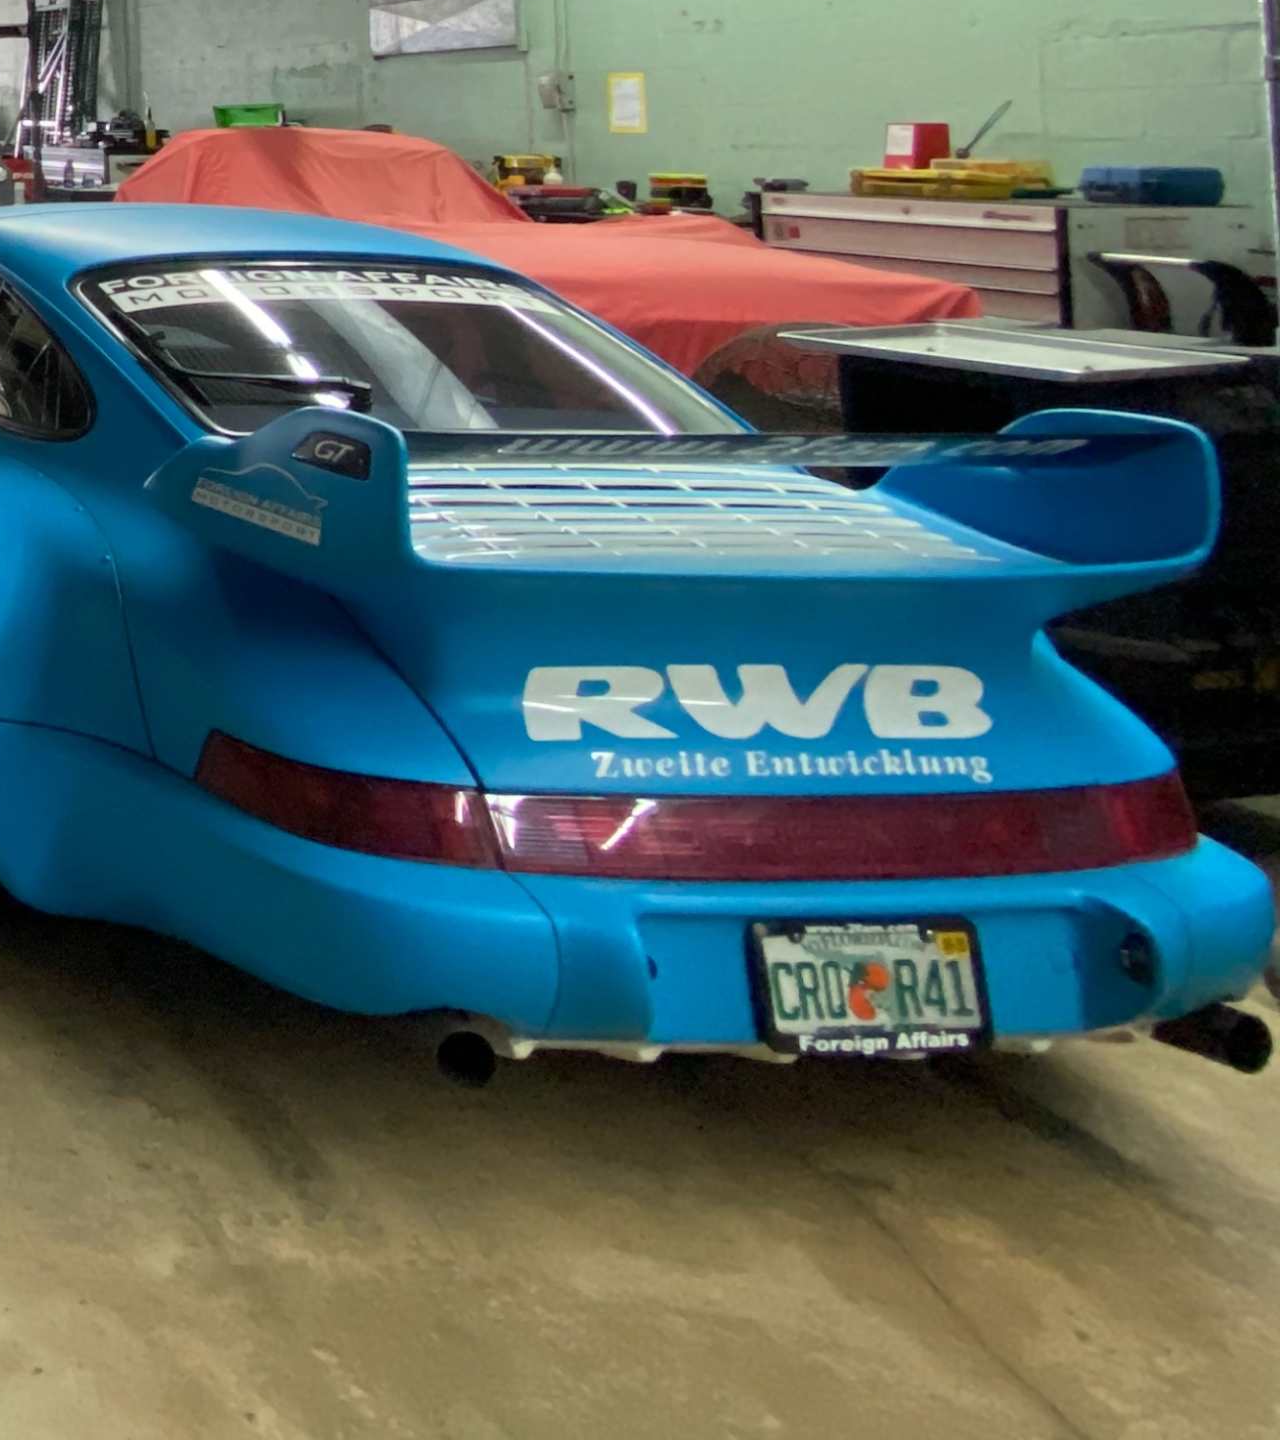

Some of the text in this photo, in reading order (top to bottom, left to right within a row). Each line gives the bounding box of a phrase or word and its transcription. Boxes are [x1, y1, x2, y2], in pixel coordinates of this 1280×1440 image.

[98, 270, 323, 295] FORIGN
[313, 440, 355, 462] GT
[522, 664, 993, 741] RWB
[590, 749, 993, 784] Zweite Entwicklung
[893, 958, 975, 1018] R41
[799, 1031, 969, 1054] Foreign Affairs
